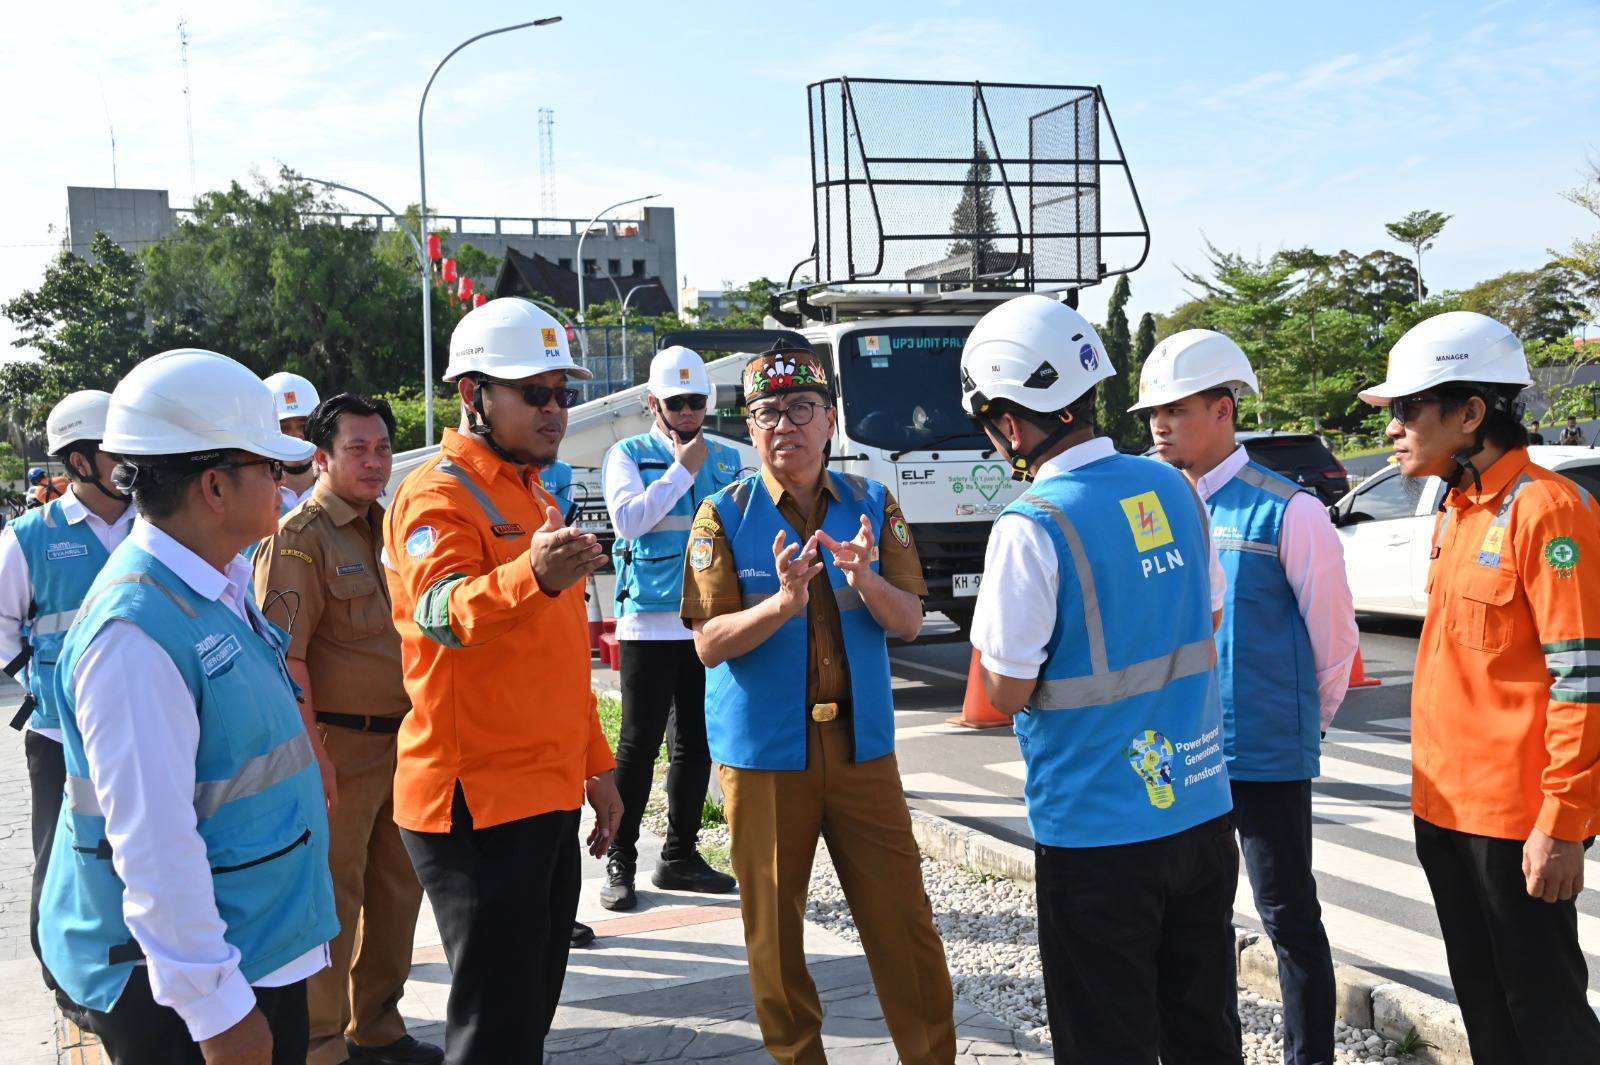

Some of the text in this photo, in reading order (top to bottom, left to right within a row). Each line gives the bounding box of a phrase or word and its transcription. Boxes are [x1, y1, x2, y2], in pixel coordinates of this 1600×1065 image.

[893, 337, 967, 349] UP3 UNIT PAL
[545, 349, 560, 358] PLN
[1436, 353, 1469, 362] MANAGER
[901, 470, 936, 480] ELF
[1141, 548, 1185, 579] PLN
[954, 576, 968, 589] KH
[1175, 738, 1201, 753] Power
